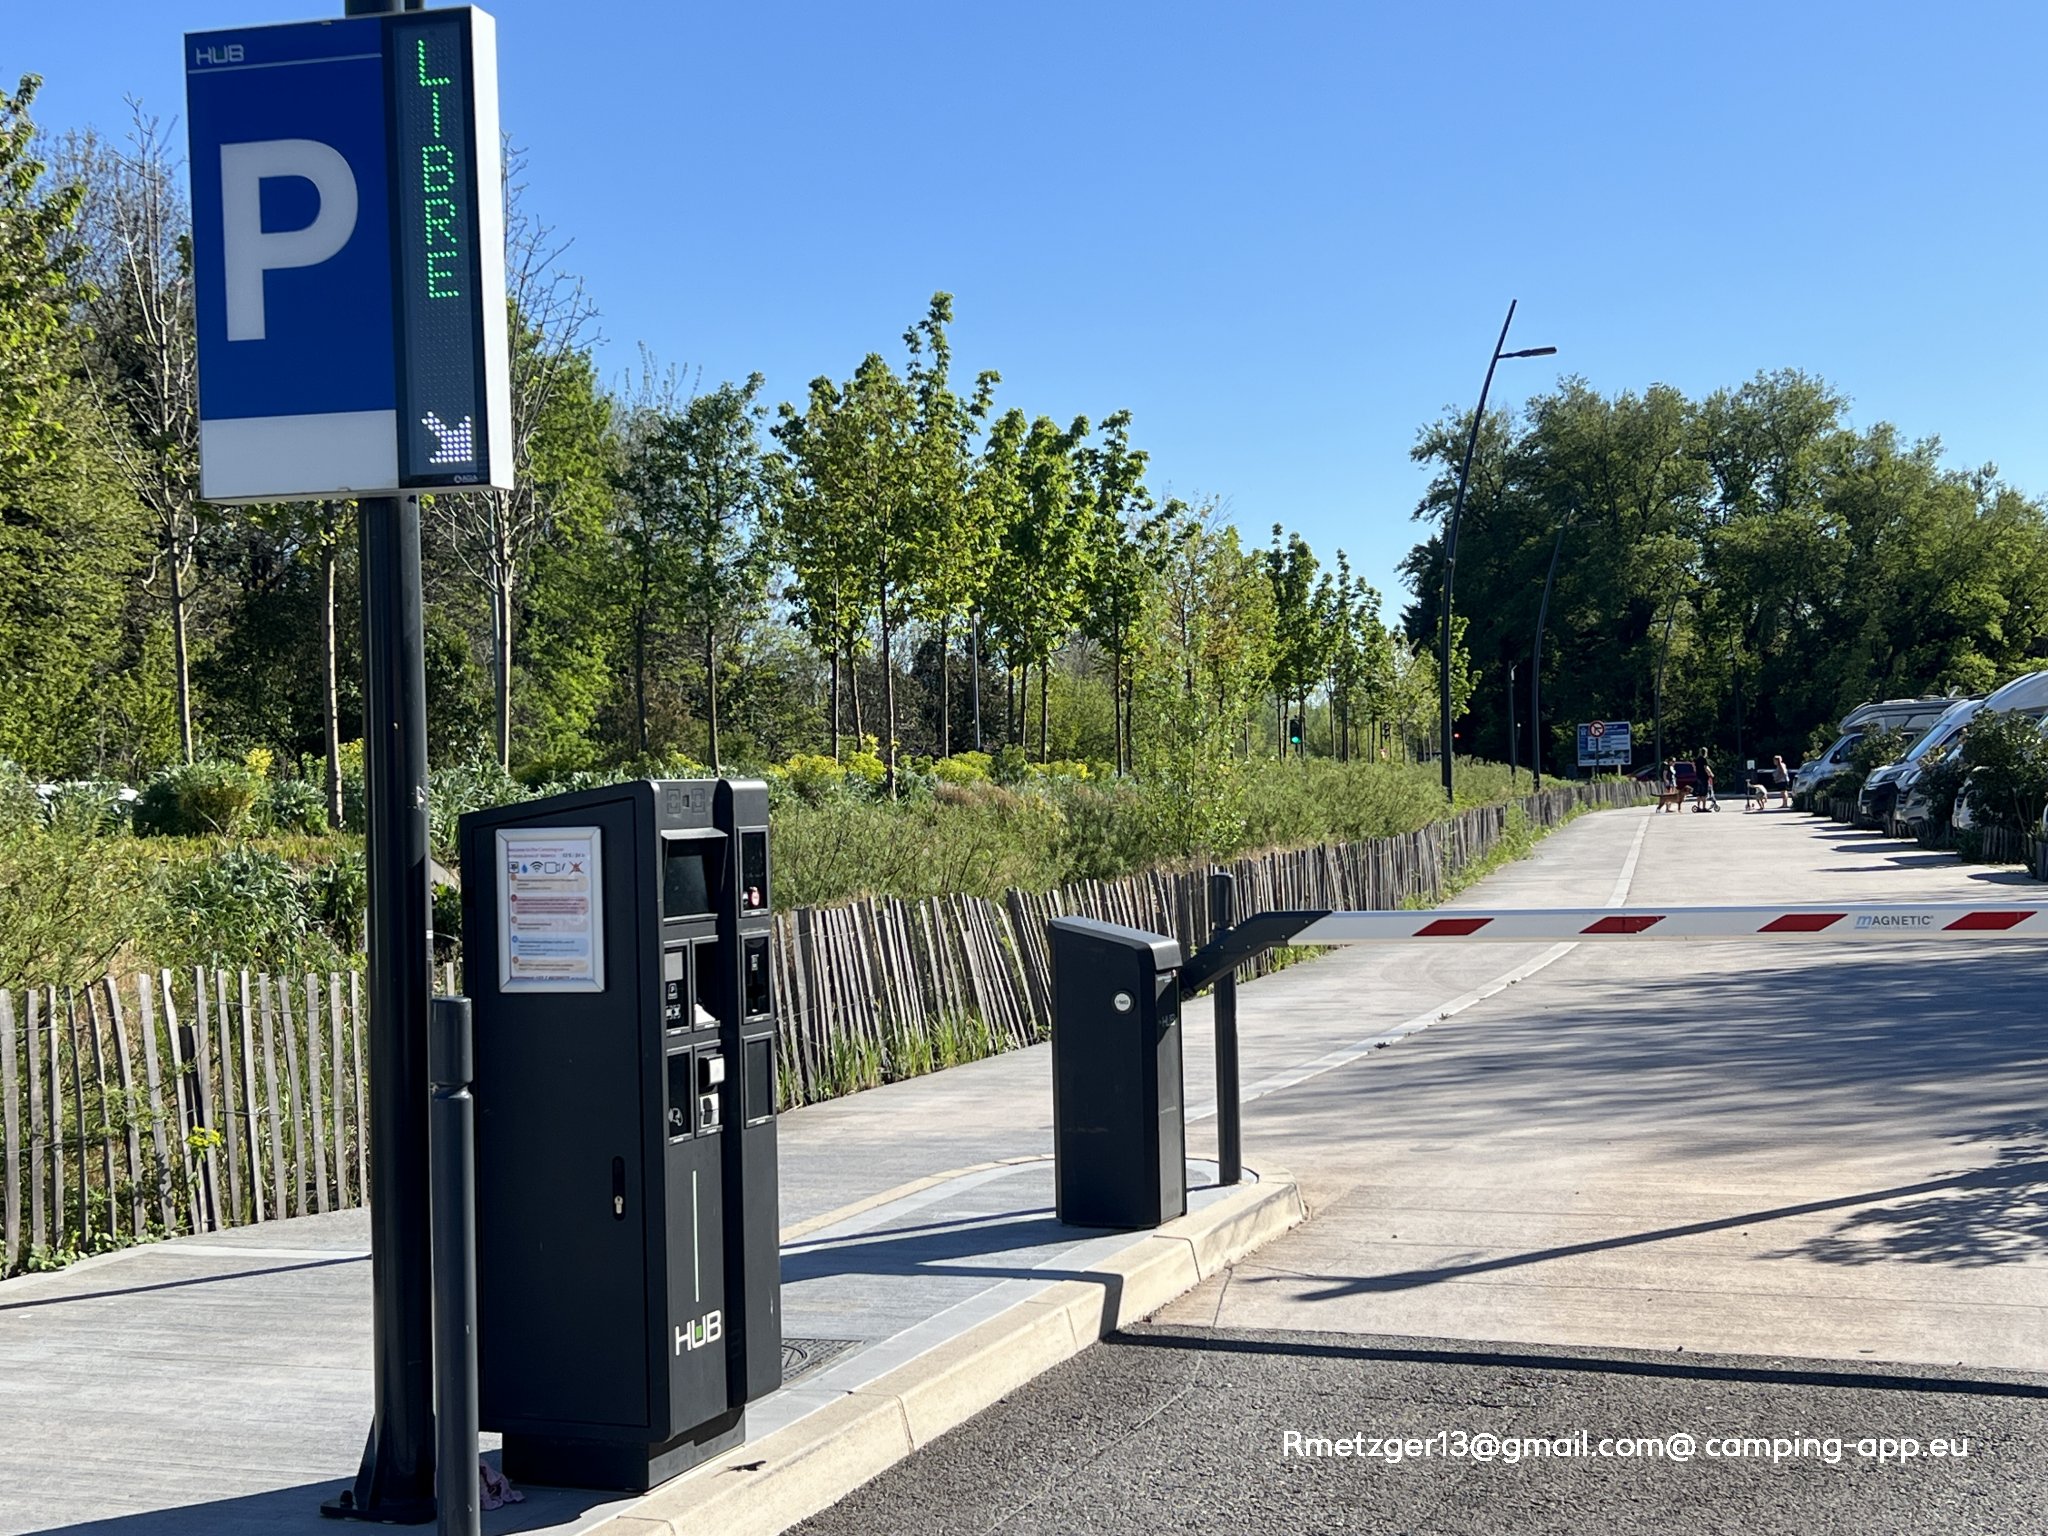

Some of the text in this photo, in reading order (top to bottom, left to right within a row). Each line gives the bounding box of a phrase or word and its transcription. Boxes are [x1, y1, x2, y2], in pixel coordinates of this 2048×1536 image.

[195, 44, 244, 66] HUB
[417, 39, 459, 298] LIBRE
[220, 138, 358, 342] P
[675, 1310, 721, 1356] HUB
